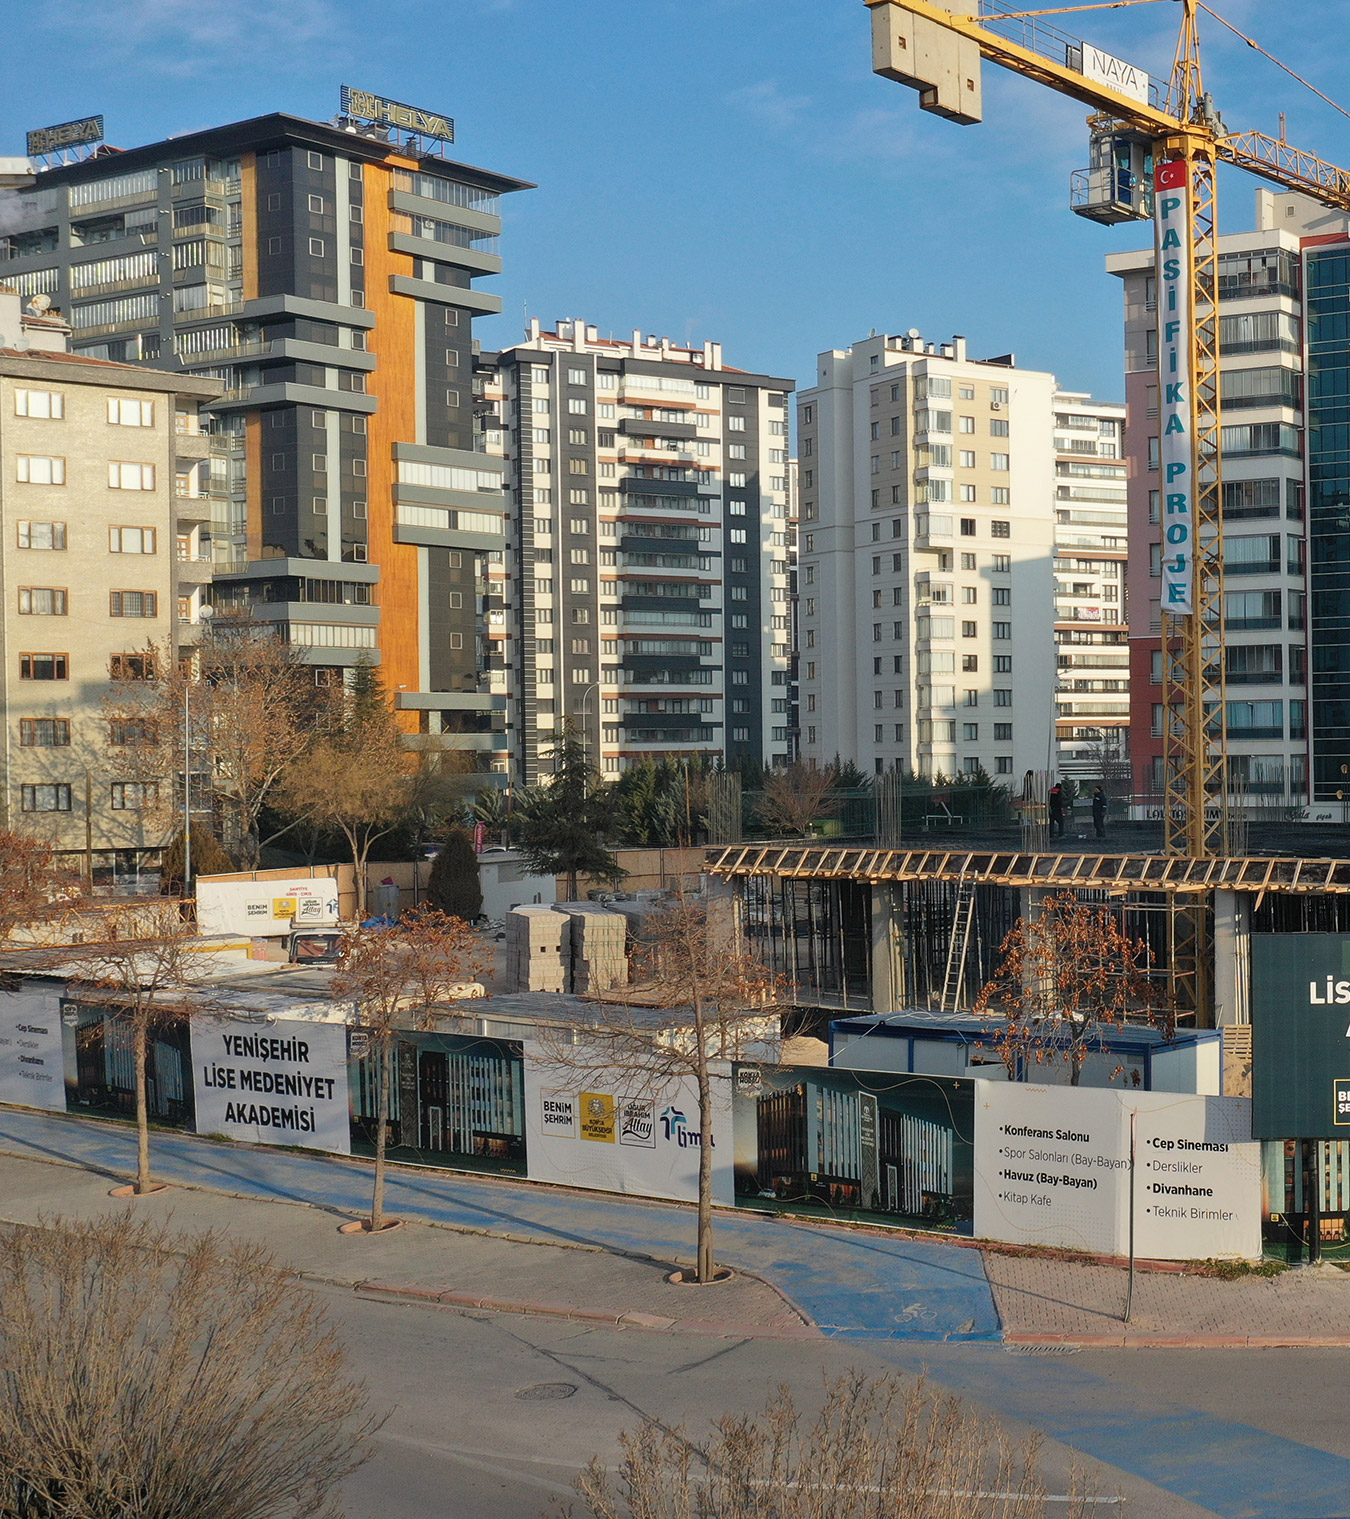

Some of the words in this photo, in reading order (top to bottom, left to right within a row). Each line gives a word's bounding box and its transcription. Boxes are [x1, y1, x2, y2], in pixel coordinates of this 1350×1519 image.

[1093, 49, 1138, 91] NAYA
[375, 99, 453, 140] HELYA
[1161, 197, 1186, 436] PASİFİKA
[1166, 462, 1188, 603] PROJE
[222, 1032, 310, 1063] YENİŞEHİR
[203, 1062, 237, 1090] LİSE
[239, 1070, 335, 1100] MEDENİYET
[224, 1101, 316, 1133] AKADEMİSİ
[1004, 1124, 1054, 1140] Konferans
[1055, 1129, 1090, 1143] Salonu
[1003, 1146, 1027, 1160] Spor
[1028, 1148, 1069, 1164] Salonları
[1152, 1137, 1175, 1151] Cep
[1177, 1139, 1229, 1153] Sineması
[1152, 1160, 1203, 1174] Derslikler
[1003, 1169, 1034, 1182] Havuz
[1036, 1172, 1098, 1190] (Bay-Bayan)
[1152, 1183, 1214, 1197] Divanhane
[1003, 1191, 1029, 1205] Kitap
[1030, 1193, 1052, 1207] Kafe
[1152, 1205, 1188, 1218] Teknik
[1190, 1207, 1234, 1221] Birimler
